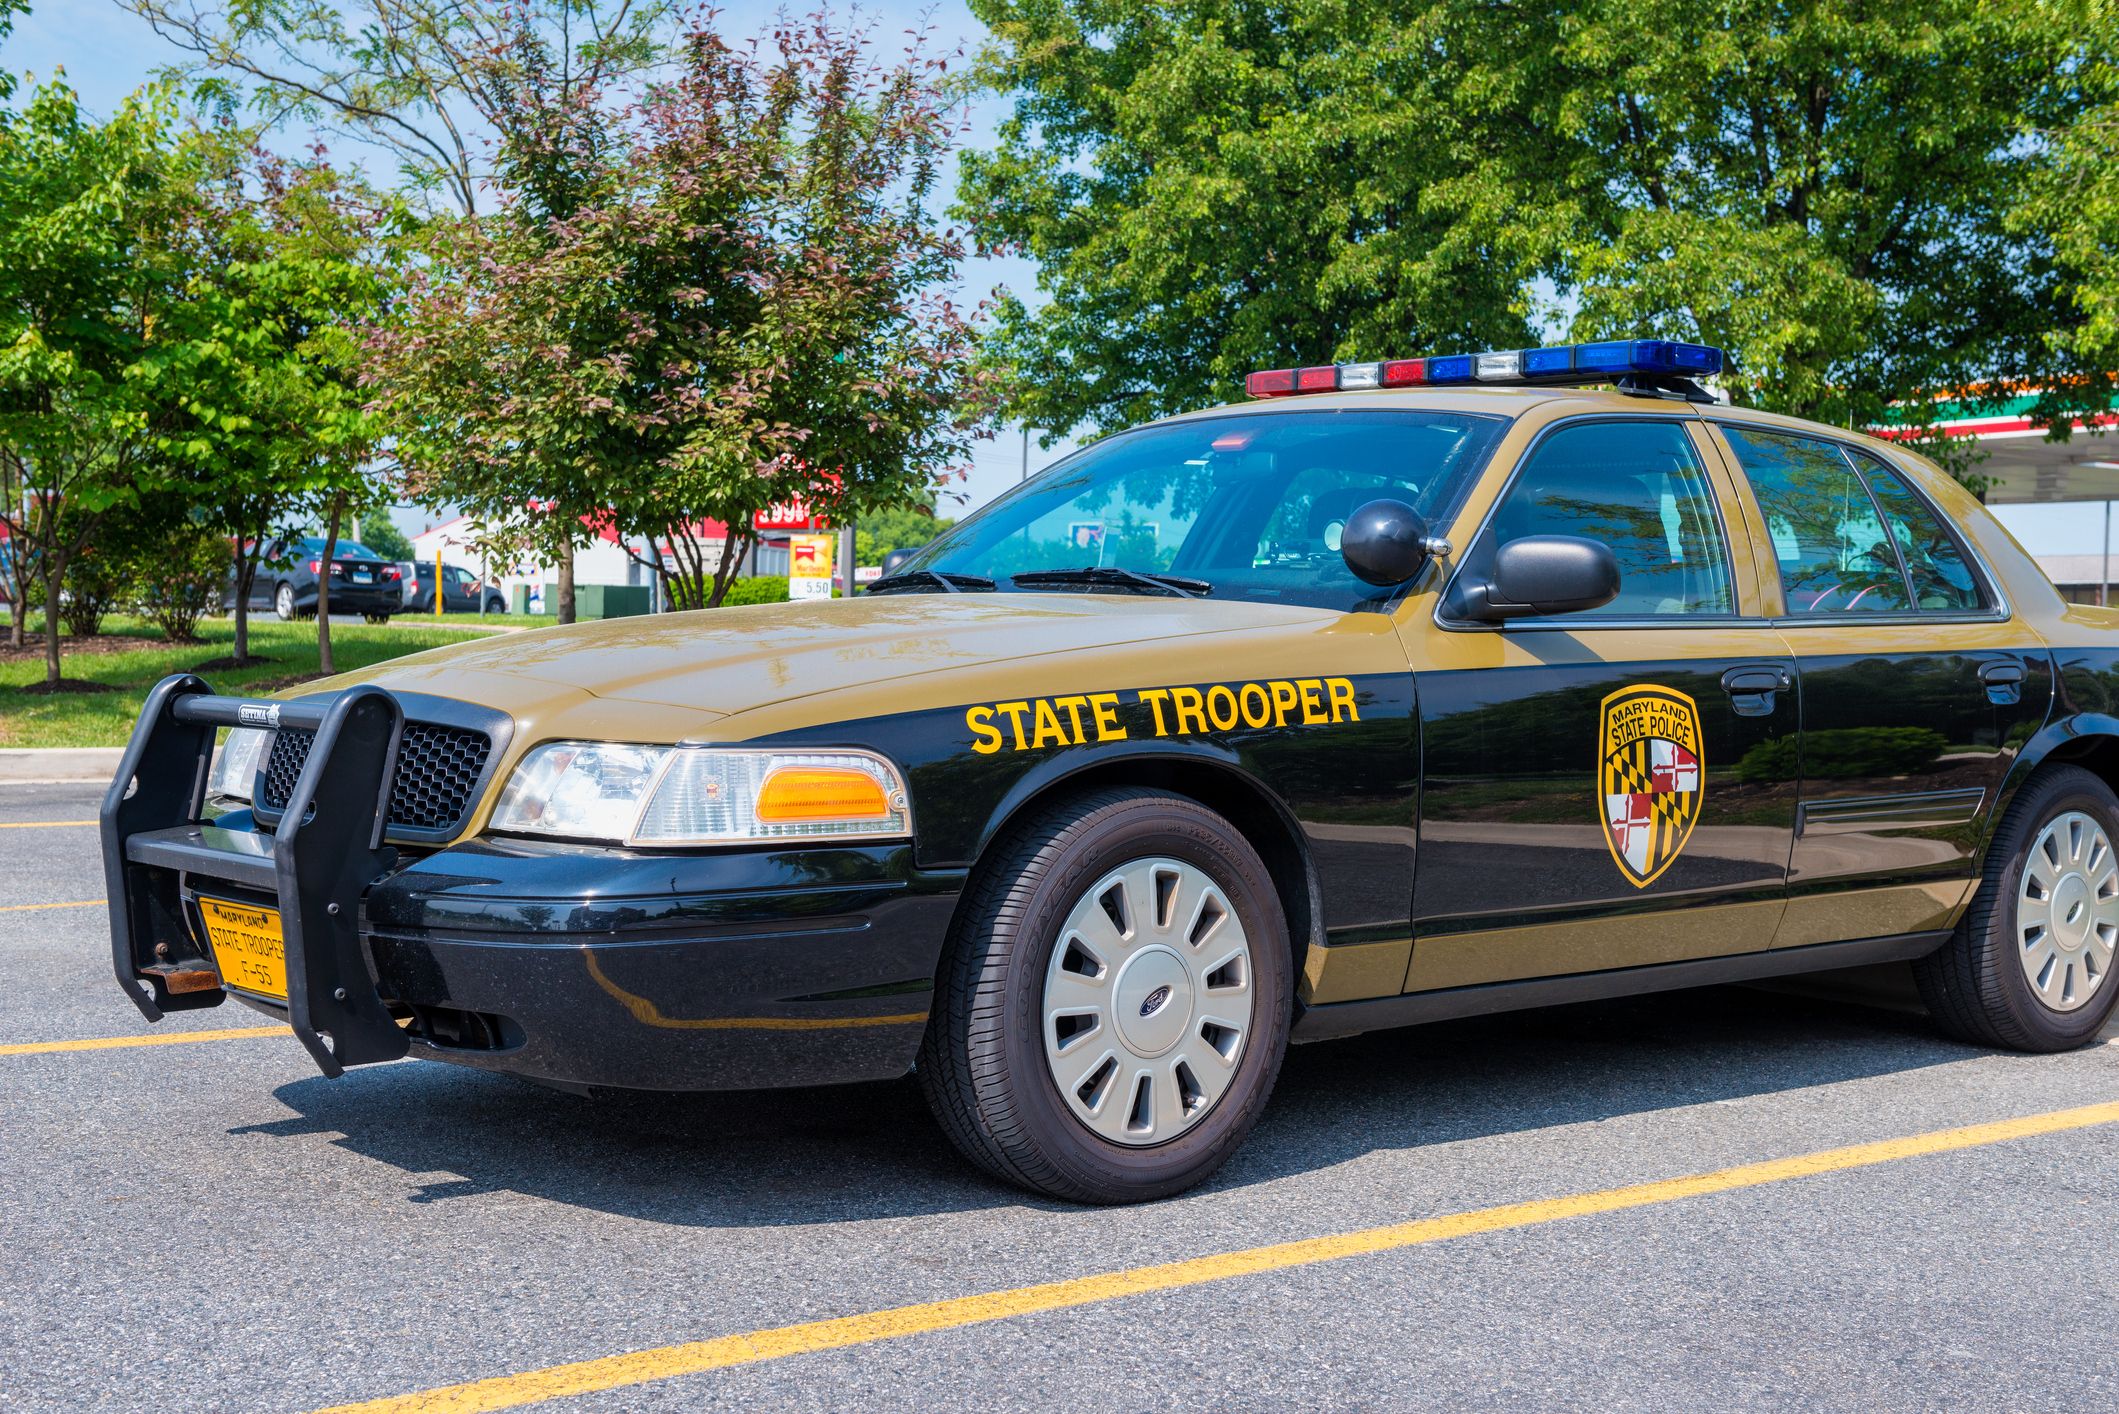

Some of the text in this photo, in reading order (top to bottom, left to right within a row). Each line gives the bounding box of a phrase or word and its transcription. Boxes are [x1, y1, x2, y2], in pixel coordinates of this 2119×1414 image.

[806, 581, 829, 594] 5.50
[966, 678, 1360, 754] STATE TROOPER
[1612, 701, 1687, 725] MARYLAND
[1611, 716, 1690, 747] STATE POLICE
[220, 910, 264, 929] MARYLAND
[211, 926, 243, 952] STATE
[1018, 848, 1100, 1043] GOODYEAR
[241, 960, 272, 986] F-55
[1143, 989, 1167, 1014] Ford
